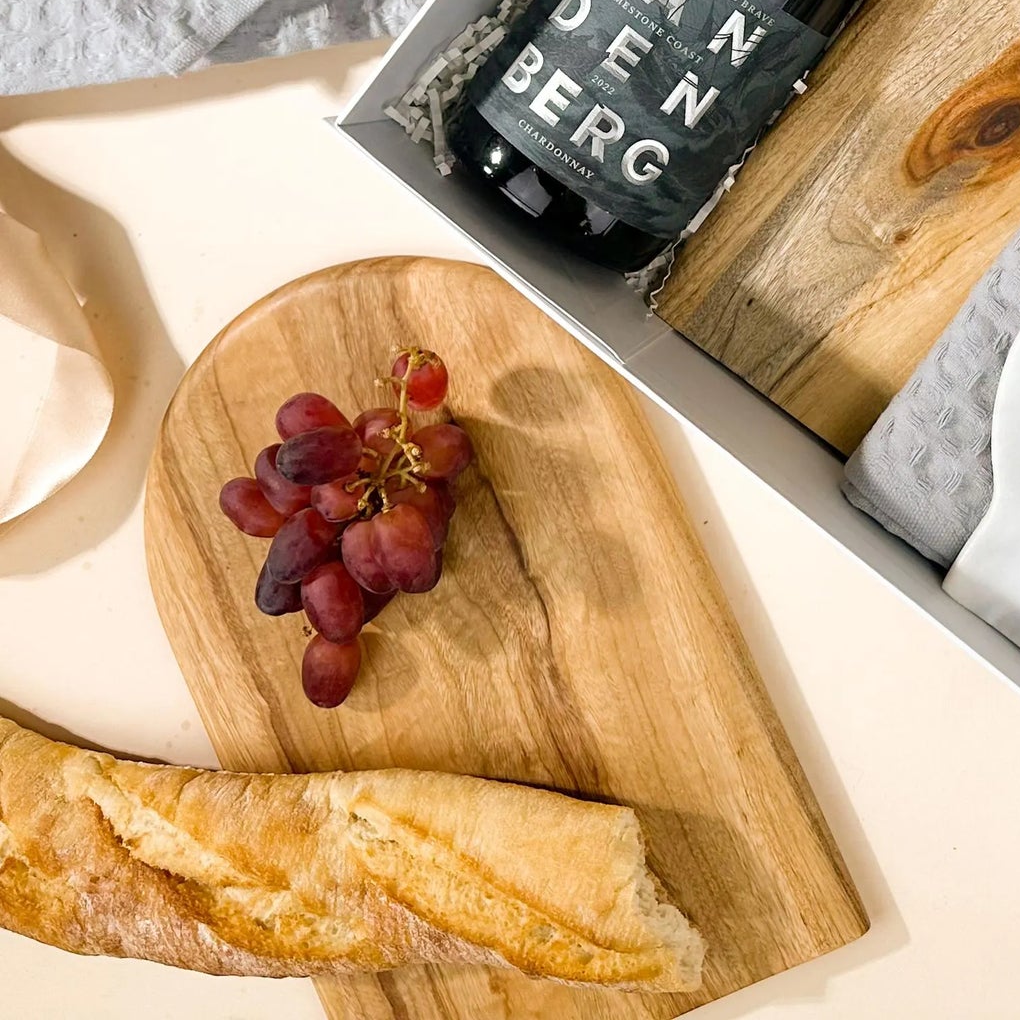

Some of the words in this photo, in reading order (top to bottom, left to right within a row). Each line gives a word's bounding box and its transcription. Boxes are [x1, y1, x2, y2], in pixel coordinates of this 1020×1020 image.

[740, 0, 777, 28] BRAVE
[666, 34, 704, 65] COAST
[590, 74, 616, 96] 2022
[500, 41, 671, 186] BERG
[517, 118, 596, 180] CHARDONNAY
